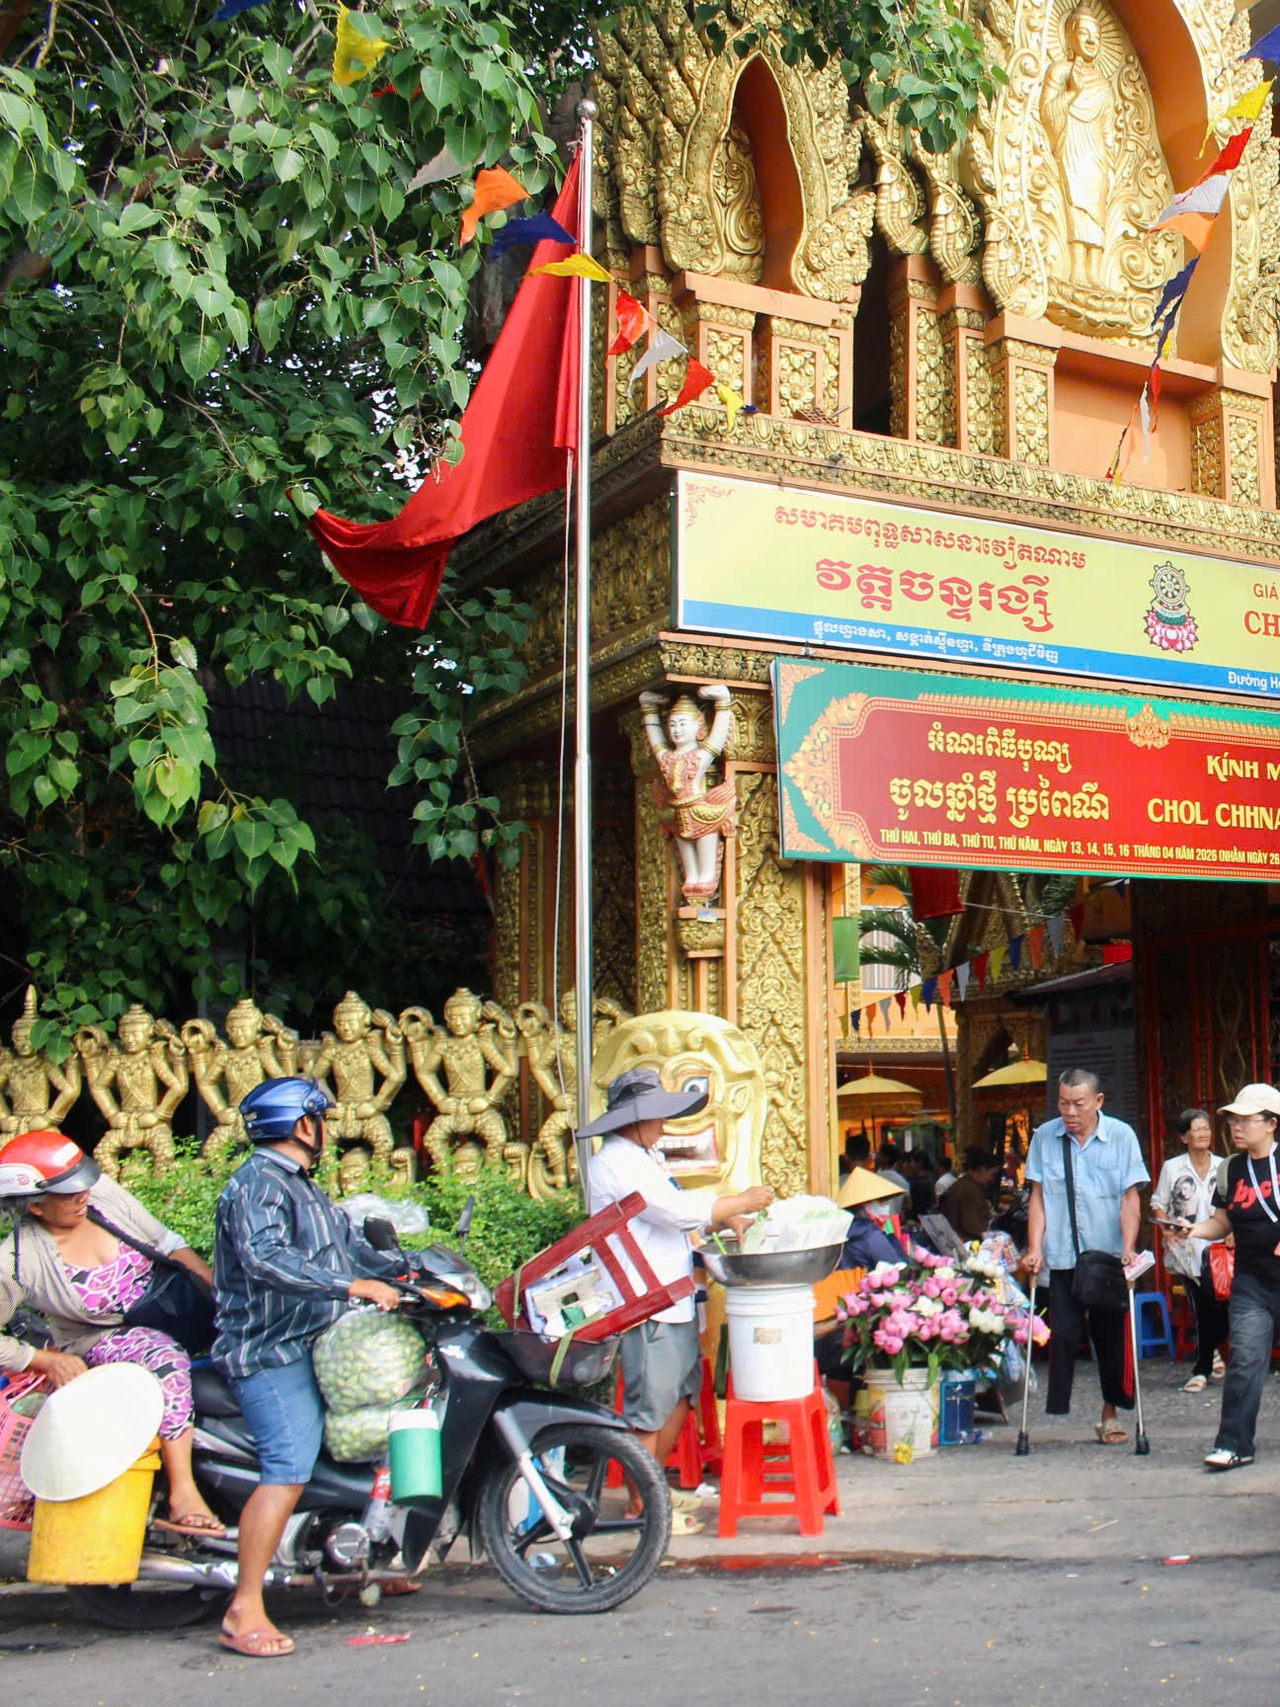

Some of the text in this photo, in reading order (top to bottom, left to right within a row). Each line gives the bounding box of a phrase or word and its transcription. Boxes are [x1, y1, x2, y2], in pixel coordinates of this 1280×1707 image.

[1228, 671, 1267, 691] Đường
[1206, 751, 1259, 783] KÍNH
[1147, 797, 1209, 826] CHOL
[880, 827, 899, 843] THỨ
[901, 831, 921, 846] HAI,
[922, 830, 942, 846] THỨ
[943, 833, 960, 848] BA,
[961, 832, 980, 849] THỨ
[998, 834, 1017, 851] THỨ
[1018, 836, 1042, 853] NĂM,
[1043, 837, 1068, 854] NGÀY
[1070, 841, 1084, 855] 13,
[1087, 842, 1100, 856] 14,
[1103, 843, 1116, 857] 15,
[1119, 844, 1129, 857] 16
[1133, 843, 1161, 859] THÁNG
[1162, 846, 1174, 859] 04
[1175, 845, 1194, 860] NĂM
[1196, 849, 1217, 862] 2026
[1219, 846, 1245, 864] (NHẰM
[1246, 849, 1268, 865] NGÀY
